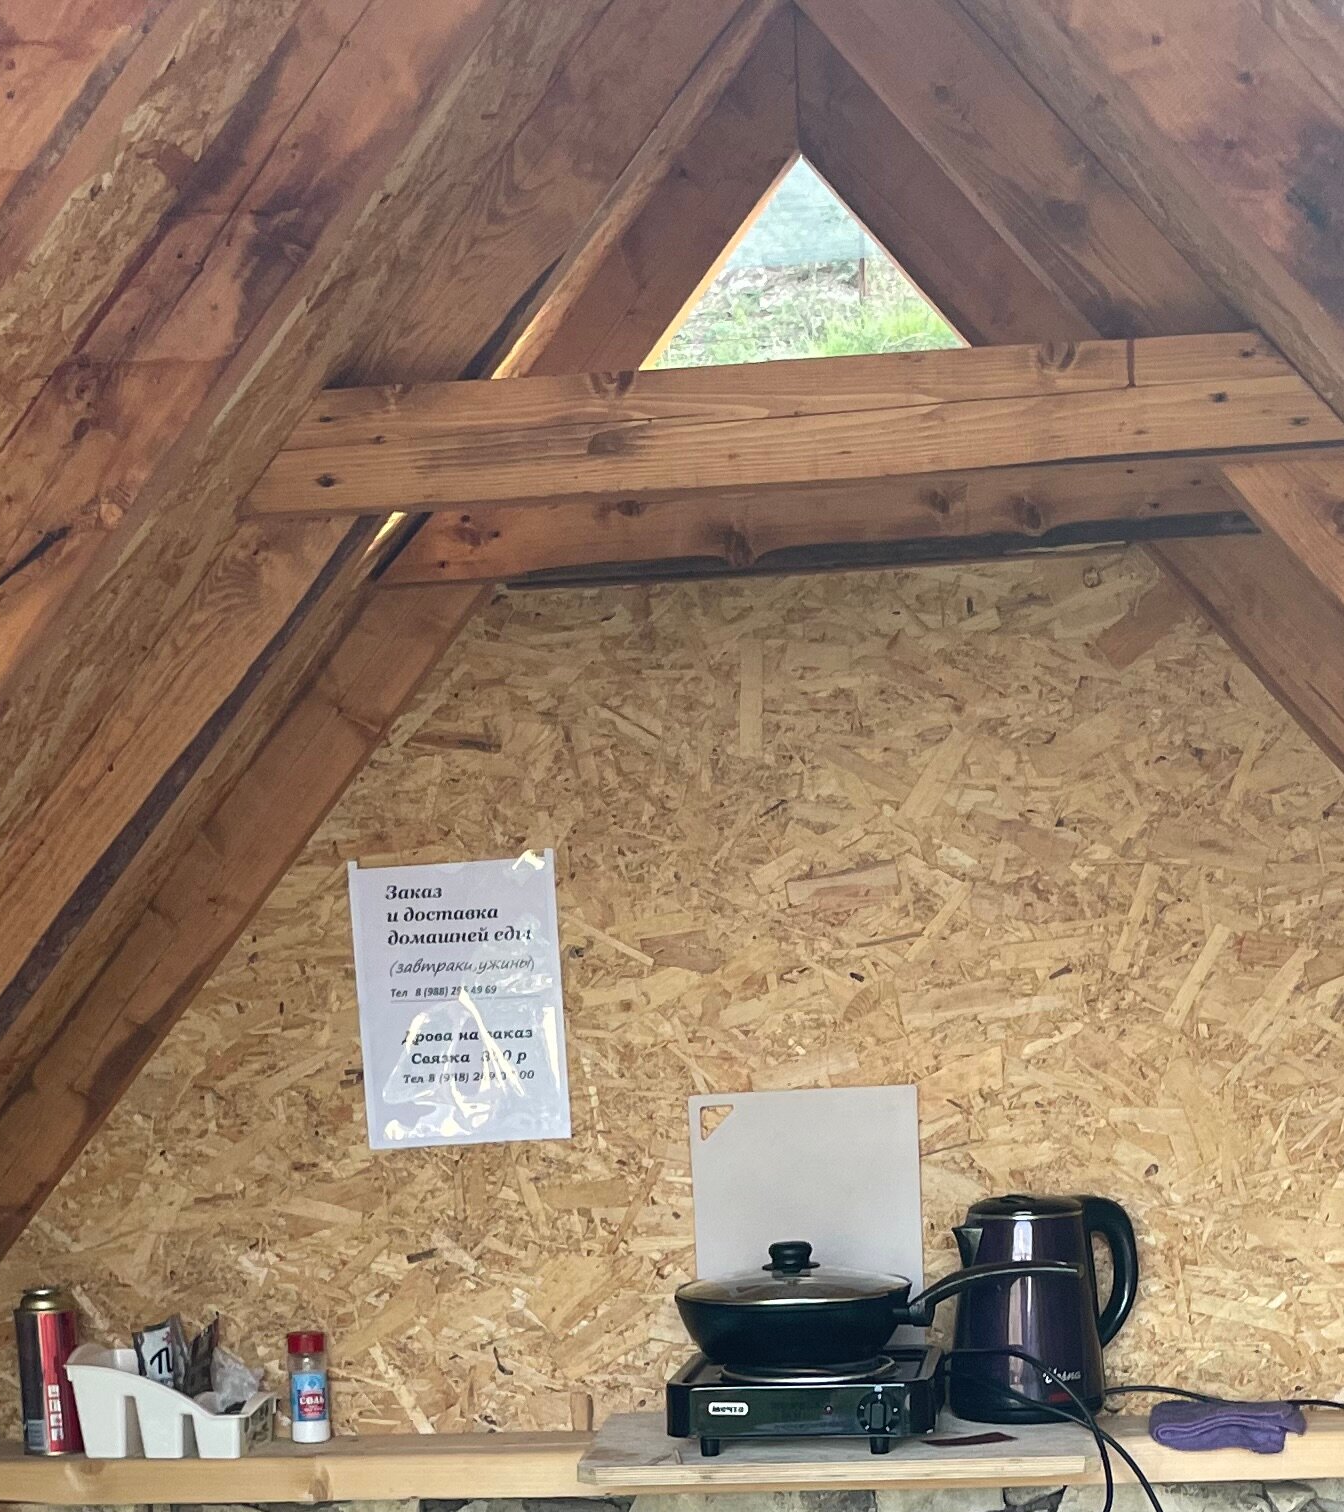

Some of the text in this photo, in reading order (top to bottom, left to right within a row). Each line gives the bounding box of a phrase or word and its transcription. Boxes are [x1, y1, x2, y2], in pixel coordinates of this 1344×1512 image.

[385, 885, 442, 900] Заказ
[386, 907, 498, 922] и доставка
[387, 926, 531, 946] домашней еды
[390, 988, 408, 998] Тел
[415, 987, 421, 997] 8
[485, 985, 497, 994] 69
[459, 1031, 479, 1041] на
[485, 1029, 533, 1039] аказ
[411, 1053, 470, 1064] Связка
[516, 1051, 527, 1064] р
[403, 1074, 424, 1084] Тел
